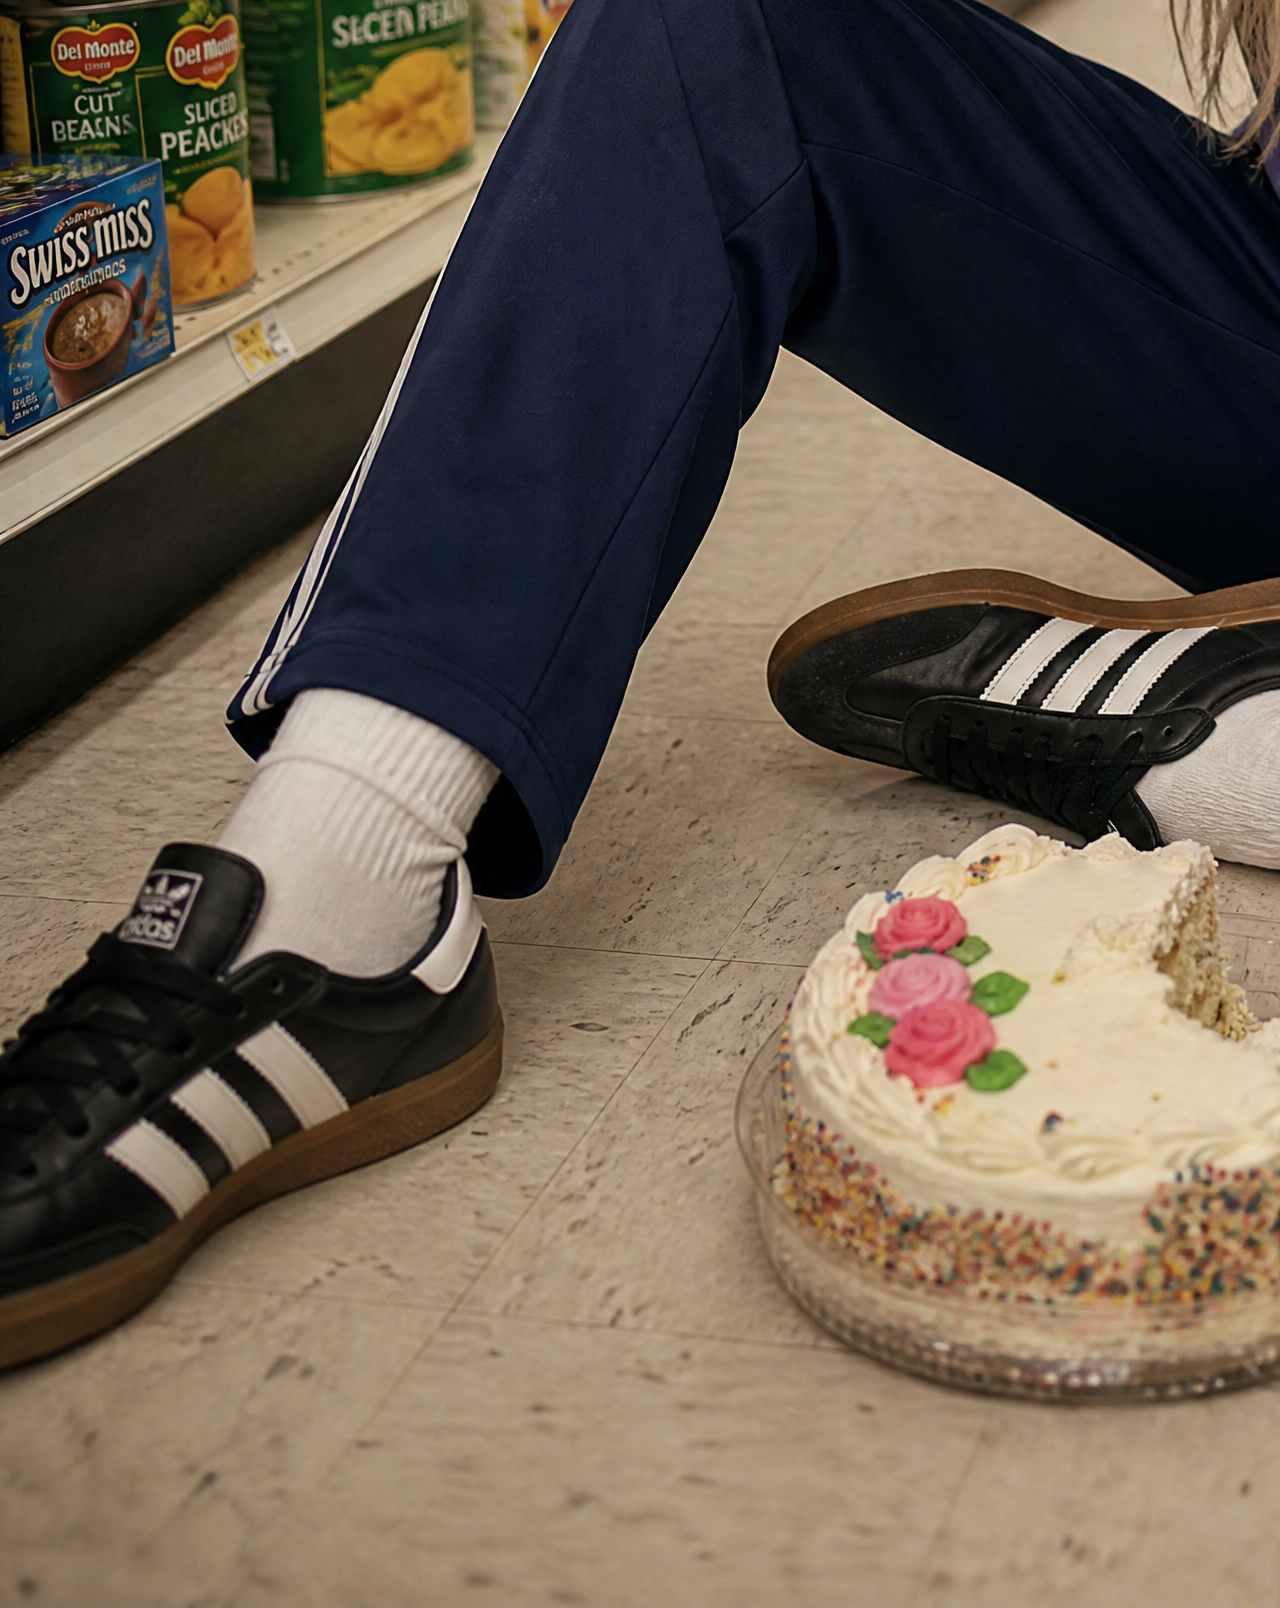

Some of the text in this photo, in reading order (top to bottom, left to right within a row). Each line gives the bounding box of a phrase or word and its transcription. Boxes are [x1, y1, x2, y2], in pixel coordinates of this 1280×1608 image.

[57, 38, 135, 61] Del Monte
[174, 43, 202, 68] Del
[74, 92, 121, 115] CUT
[183, 91, 237, 126] SLICED
[10, 226, 91, 305] SWISS
